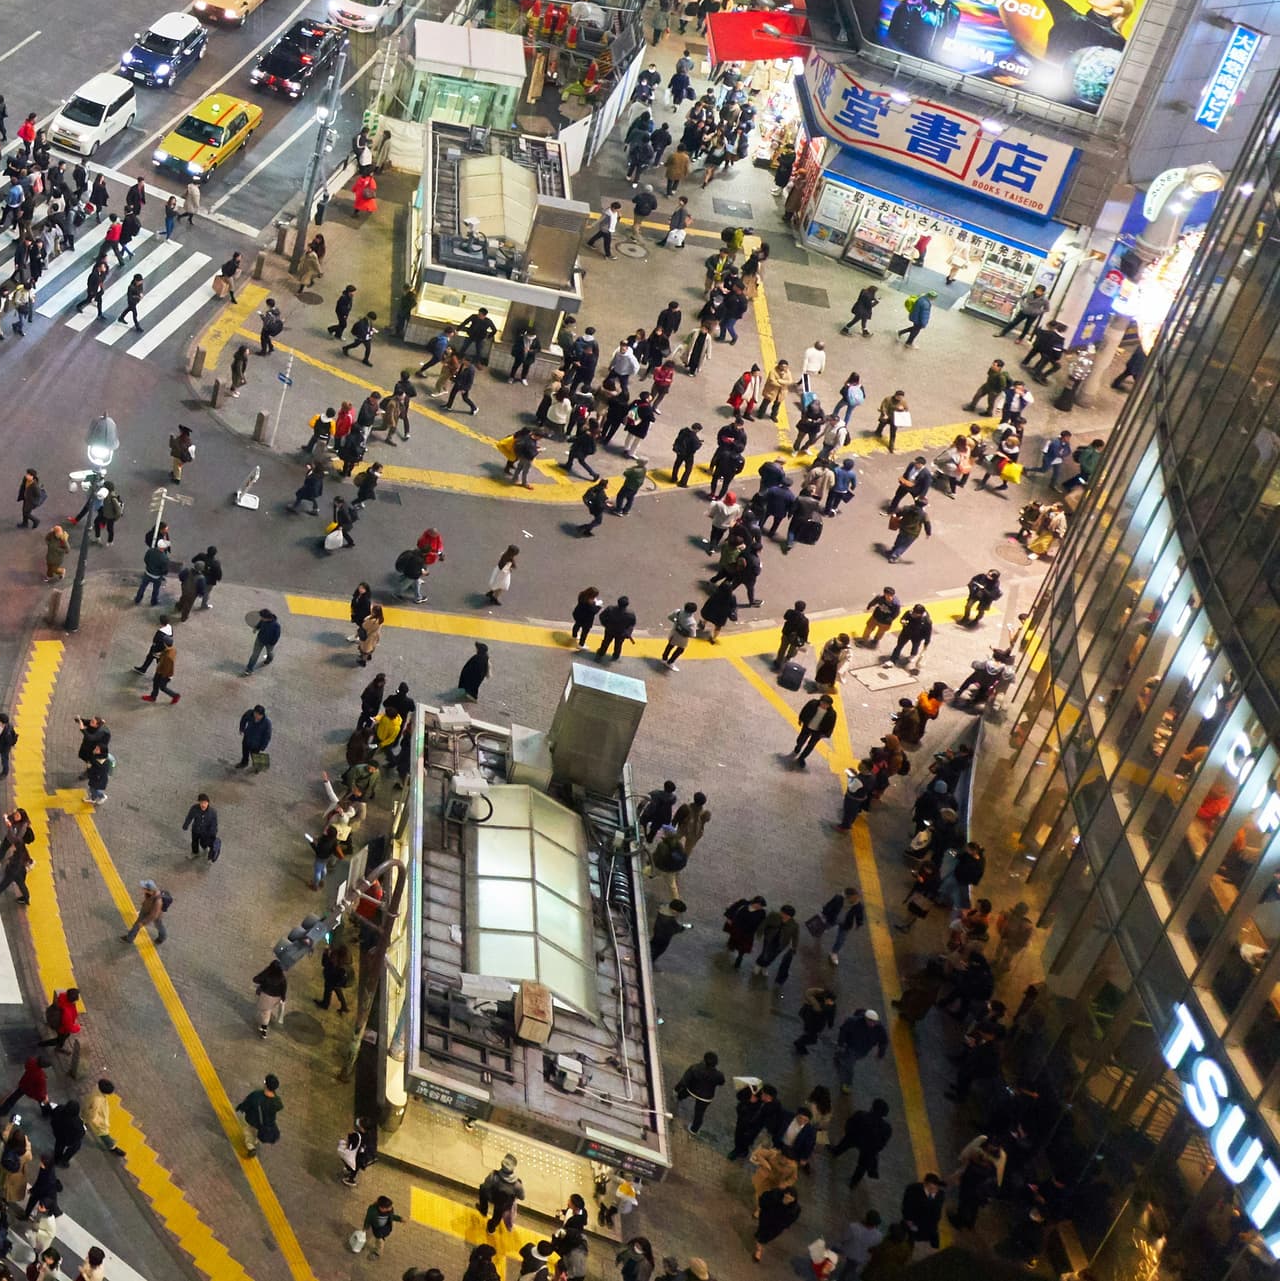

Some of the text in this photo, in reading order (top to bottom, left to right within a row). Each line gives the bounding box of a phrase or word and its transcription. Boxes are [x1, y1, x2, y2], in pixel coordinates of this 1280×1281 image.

[942, 36, 1030, 76] DMM.com
[972, 179, 1045, 211] BOOKS TAISEIDO
[1162, 1001, 1280, 1261] TSUT
